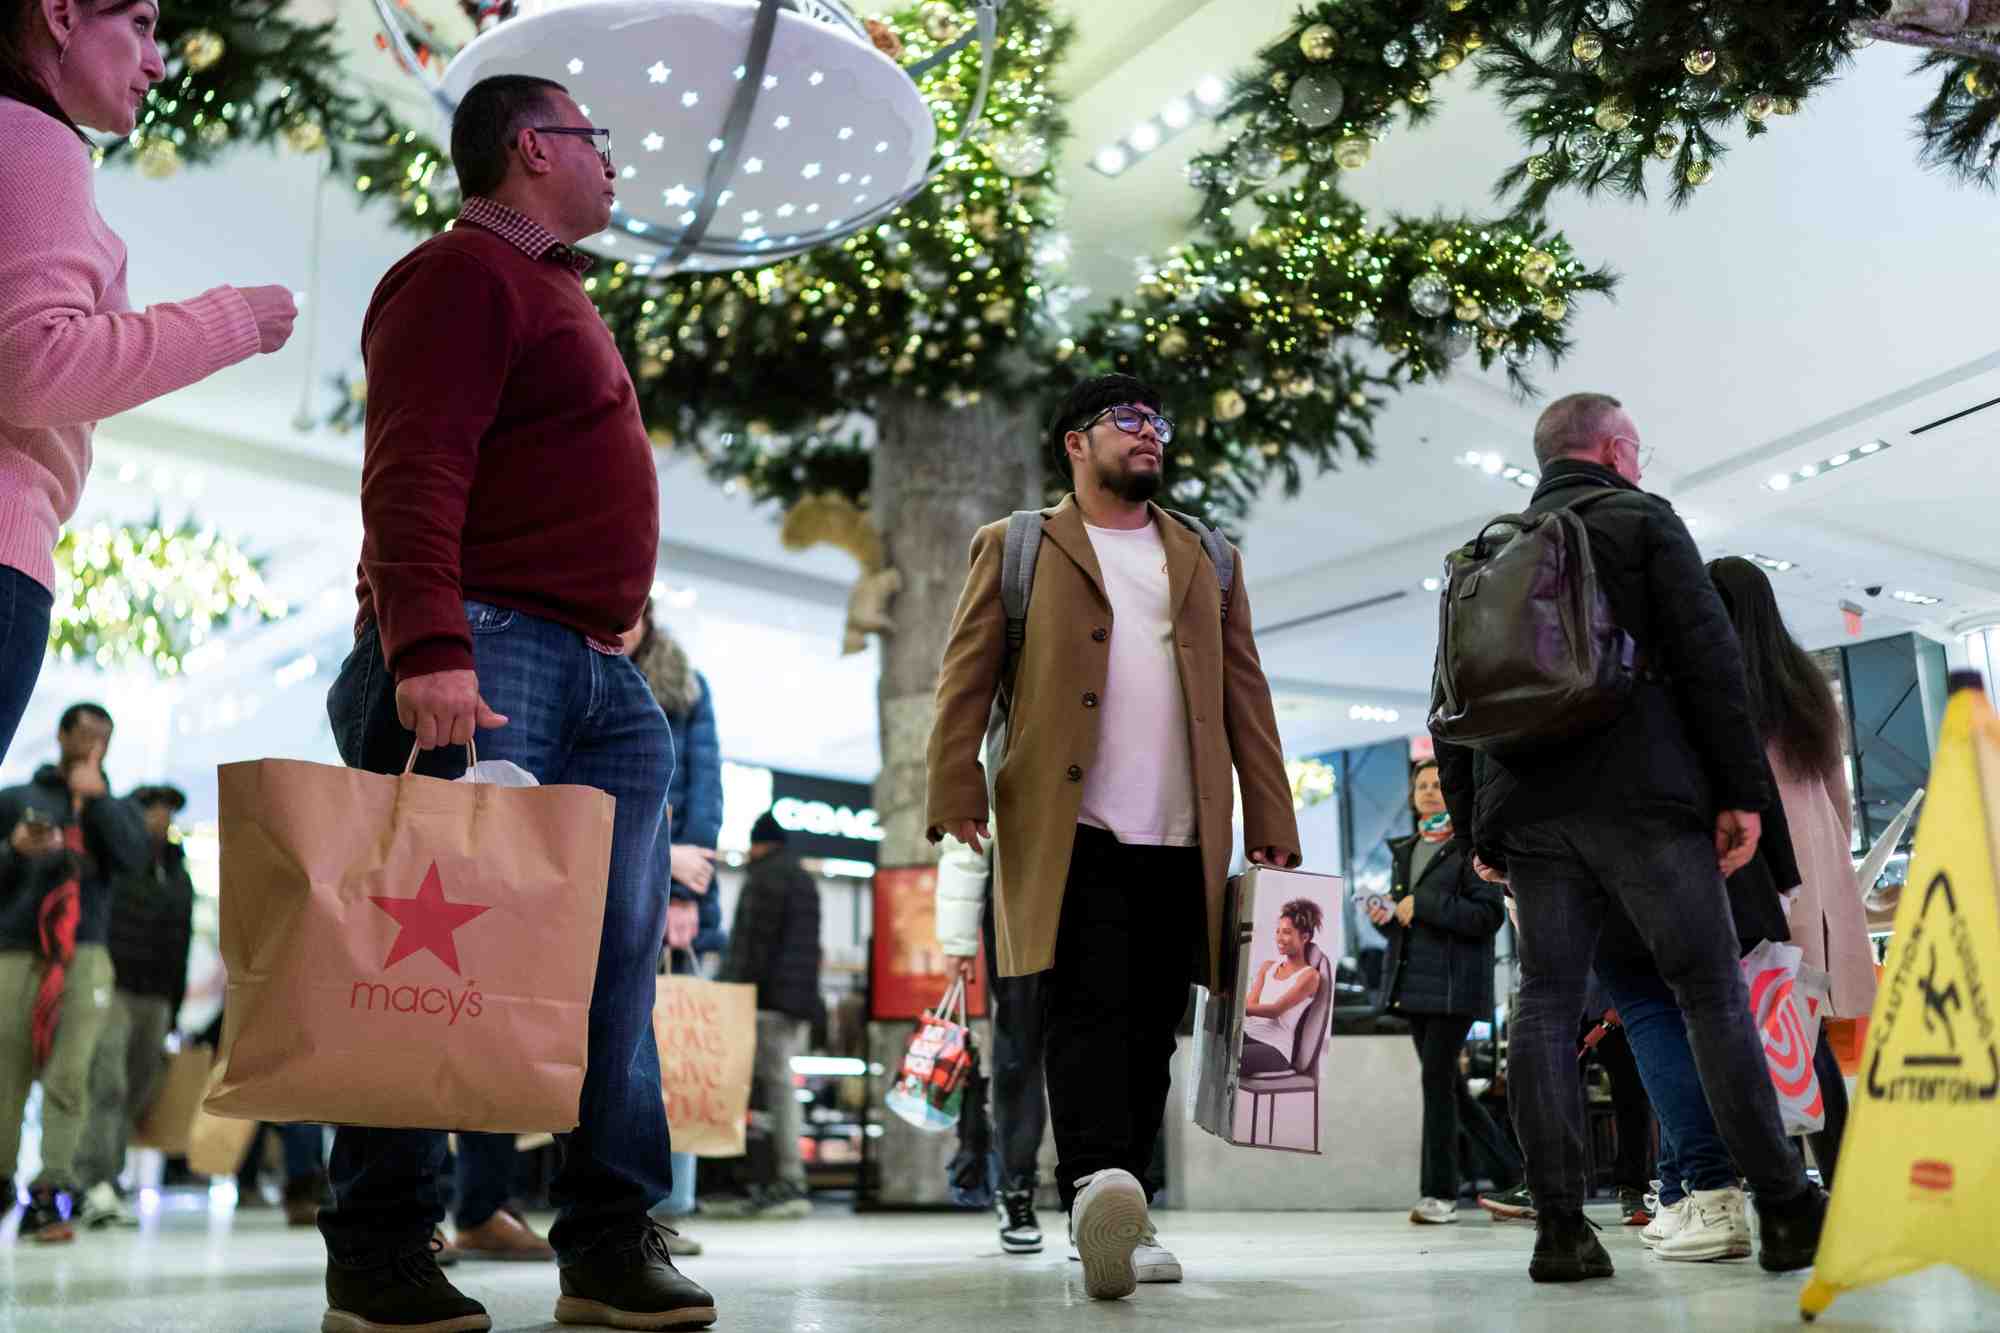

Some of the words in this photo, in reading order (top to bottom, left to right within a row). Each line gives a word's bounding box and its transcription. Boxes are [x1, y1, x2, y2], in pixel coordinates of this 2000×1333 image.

[771, 797, 886, 841] COAC
[350, 979, 483, 1026] macy's
[1873, 922, 1923, 1046] CAUTION
